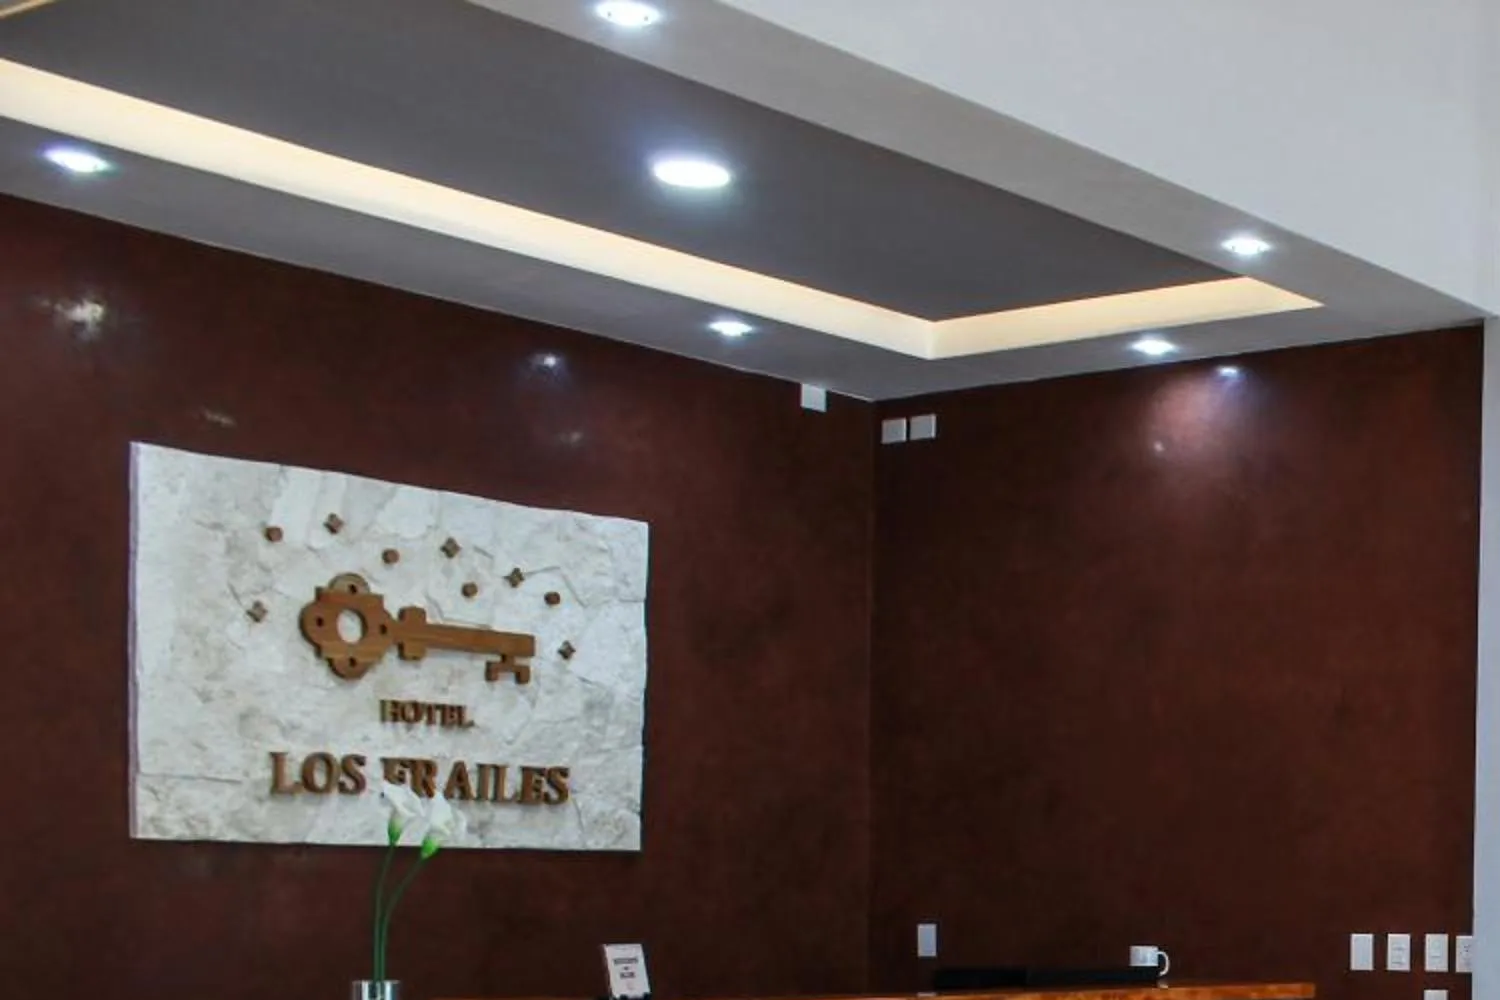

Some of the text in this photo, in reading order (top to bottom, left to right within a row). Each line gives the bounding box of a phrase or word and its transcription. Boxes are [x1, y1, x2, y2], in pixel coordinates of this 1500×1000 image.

[379, 699, 475, 728] HOTEL
[269, 751, 570, 805] LOS FRAILES
